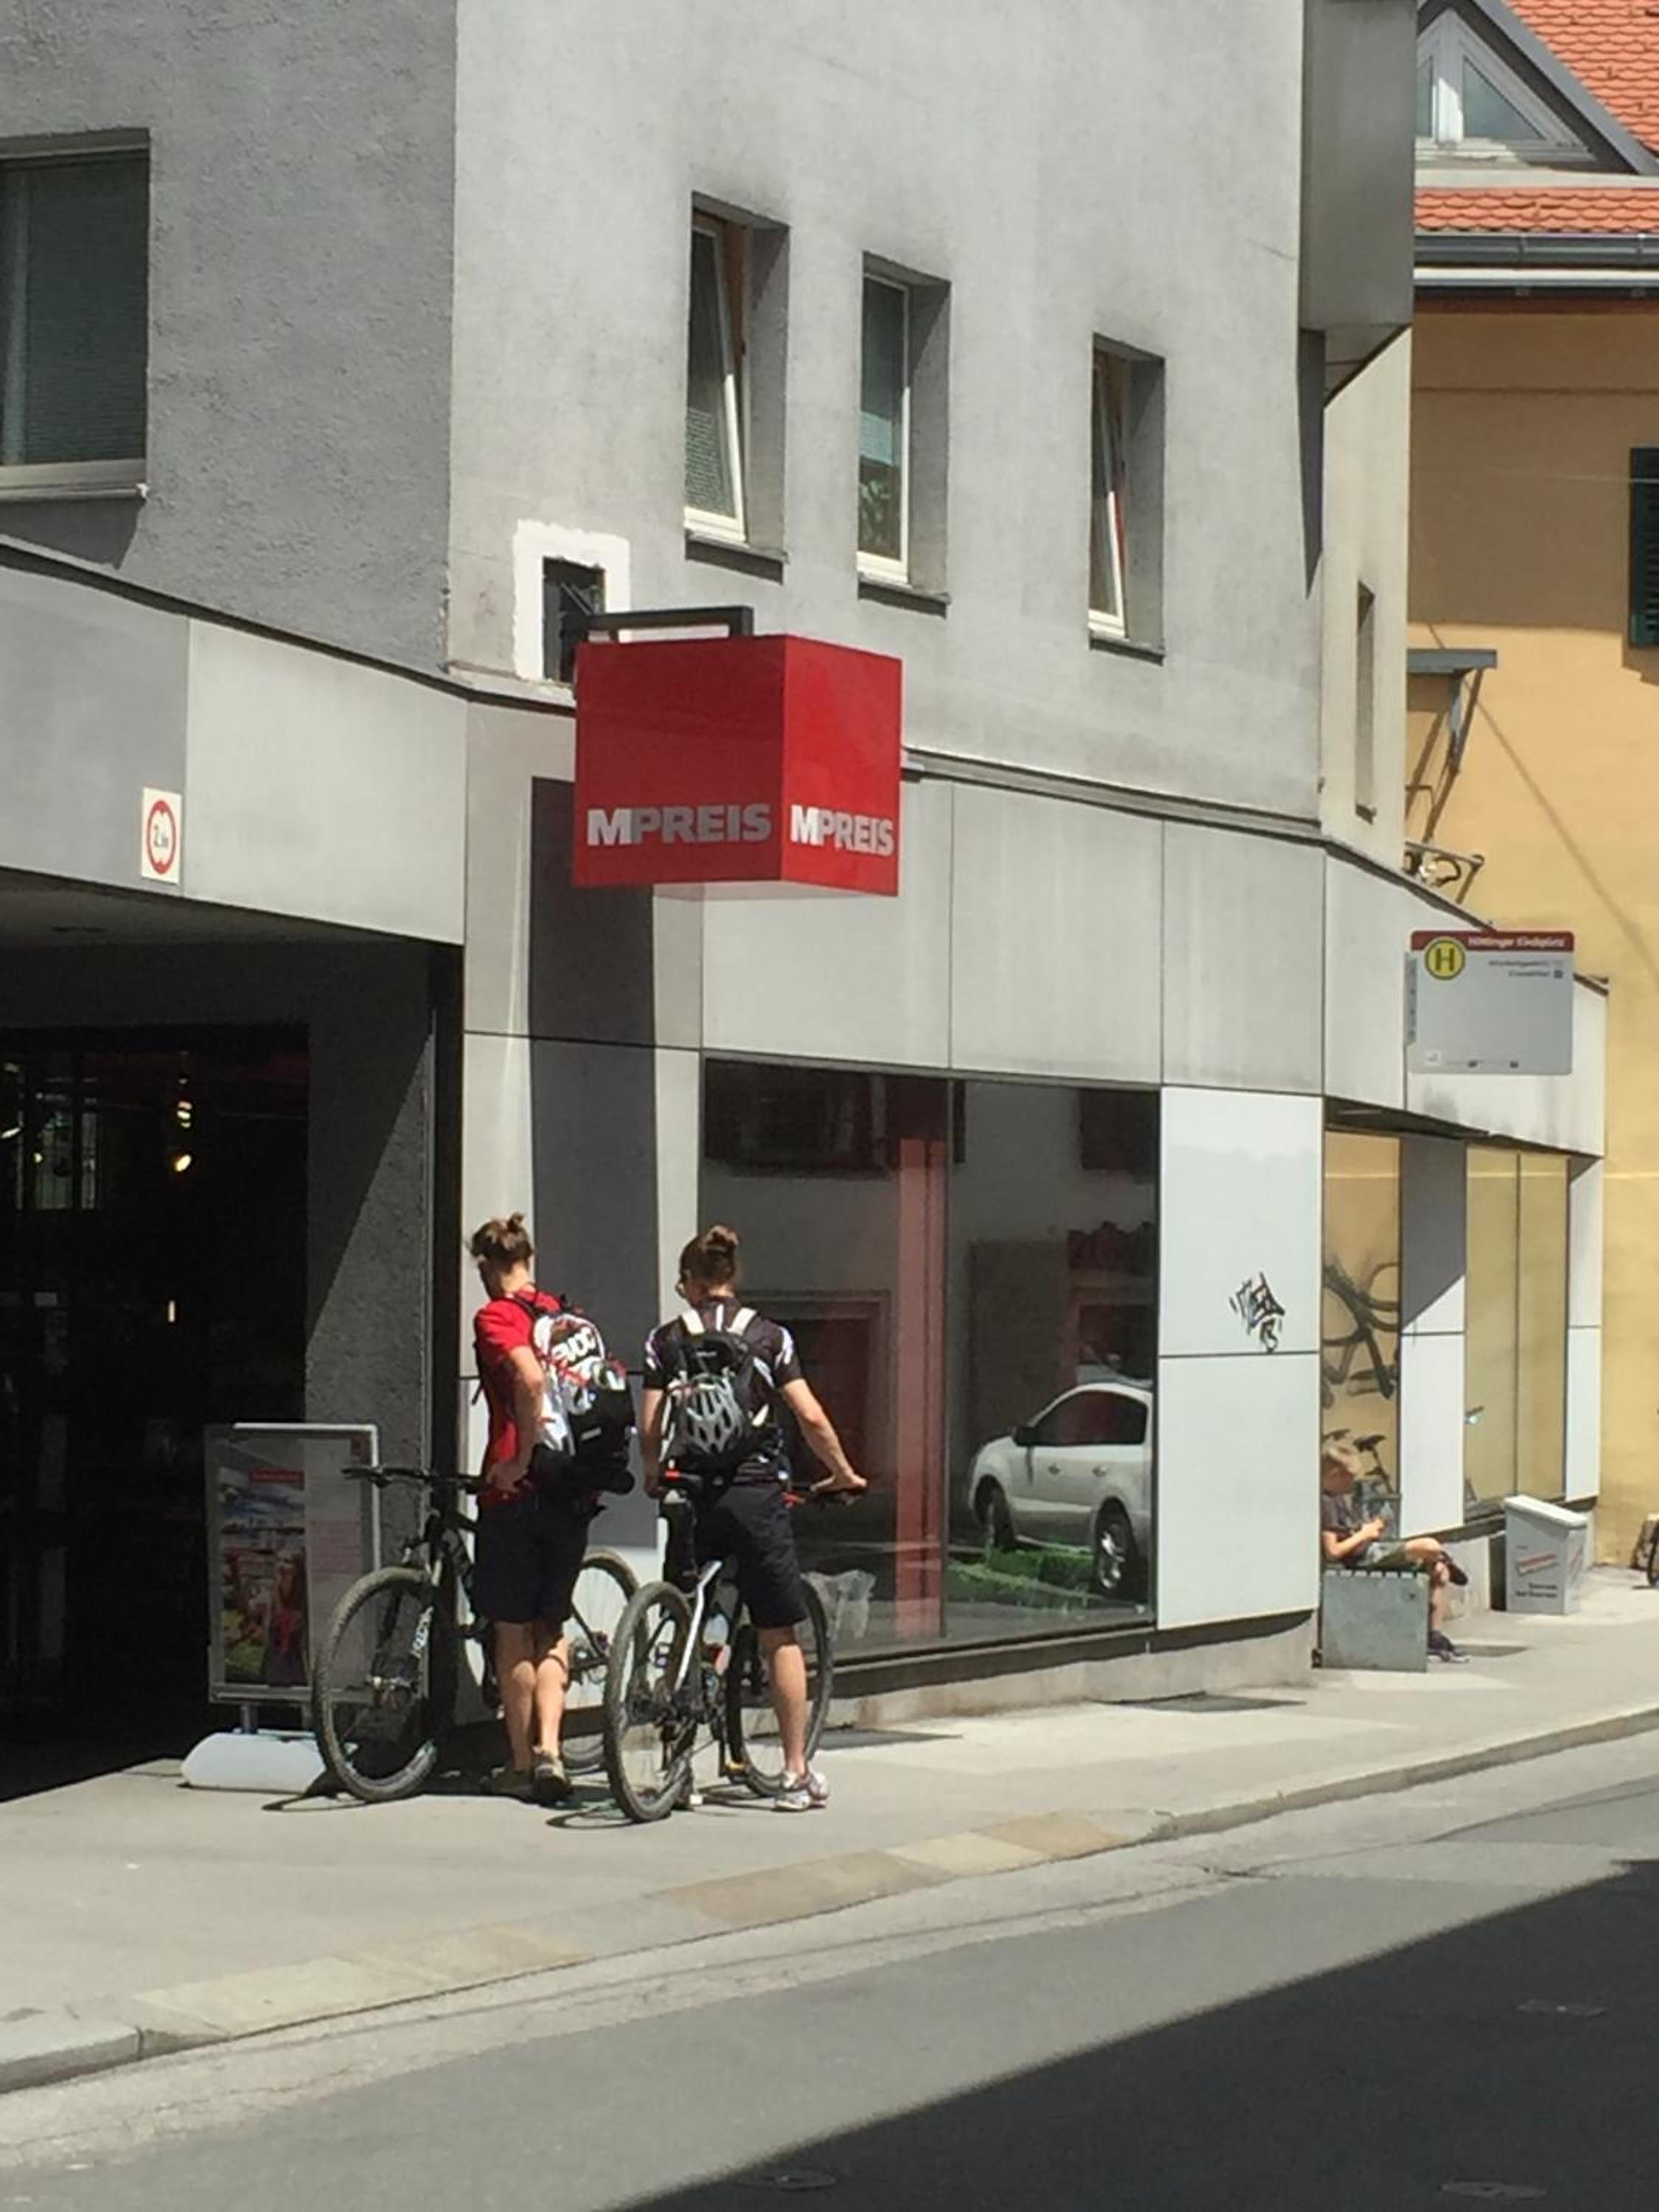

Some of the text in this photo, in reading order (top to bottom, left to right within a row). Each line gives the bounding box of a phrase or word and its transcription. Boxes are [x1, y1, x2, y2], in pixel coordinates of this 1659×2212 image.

[587, 804, 772, 846] MPREIS
[790, 804, 894, 856] MPREIS
[1434, 947, 1455, 972] H
